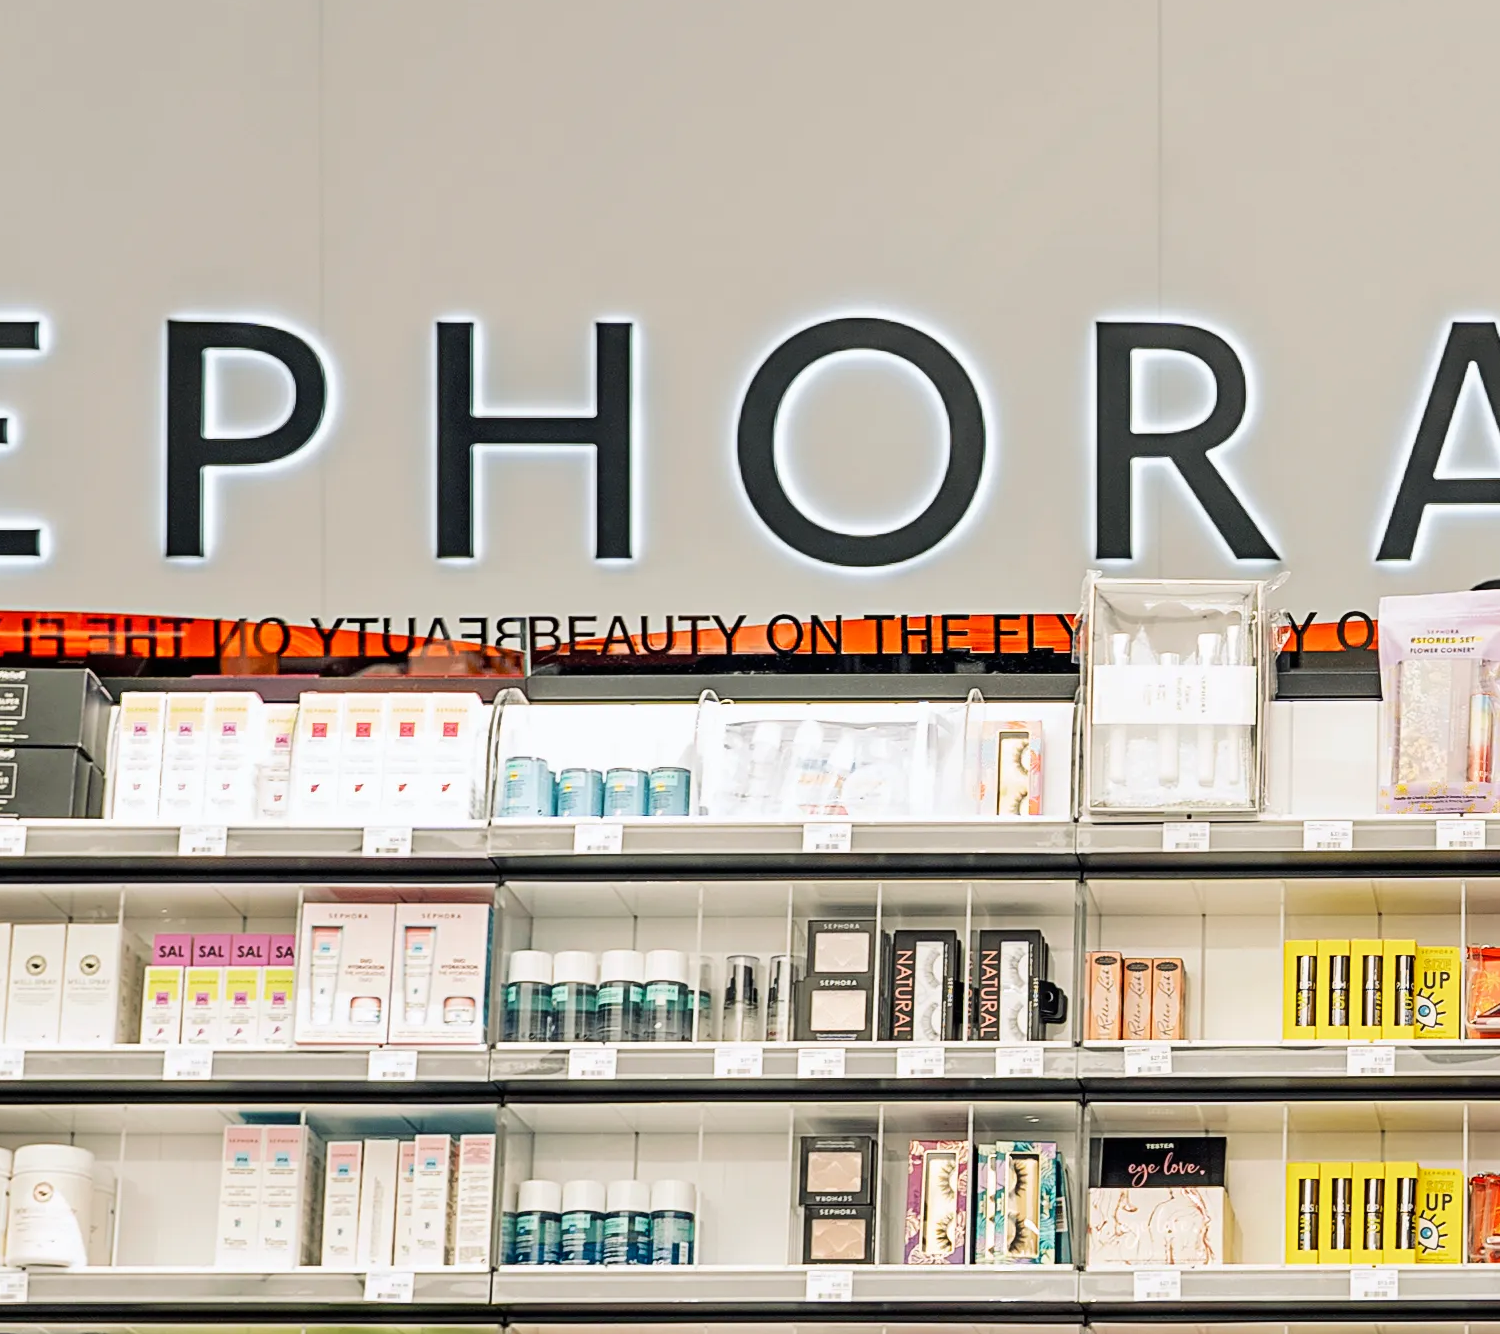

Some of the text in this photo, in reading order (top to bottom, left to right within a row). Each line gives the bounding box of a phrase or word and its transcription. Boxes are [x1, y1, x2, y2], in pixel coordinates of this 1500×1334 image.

[529, 613, 1078, 655] BEAUTY ON THE FLY
[1410, 636, 1476, 645] #STORIES SET
[823, 922, 861, 930] SEPHORA
[158, 945, 185, 959] SAL
[198, 945, 225, 959] SAL
[236, 945, 264, 959] SAL
[819, 979, 858, 987] SEPHORA
[1423, 971, 1451, 989] UP
[896, 950, 912, 1038] NATURAL
[981, 950, 997, 1038] NATURAL
[1145, 1142, 1174, 1150] TESTER
[1128, 1153, 1206, 1188] eye love.
[815, 1194, 853, 1203] SEPHORA
[1426, 1193, 1453, 1211] UP
[819, 1207, 857, 1216] SEPHORA
